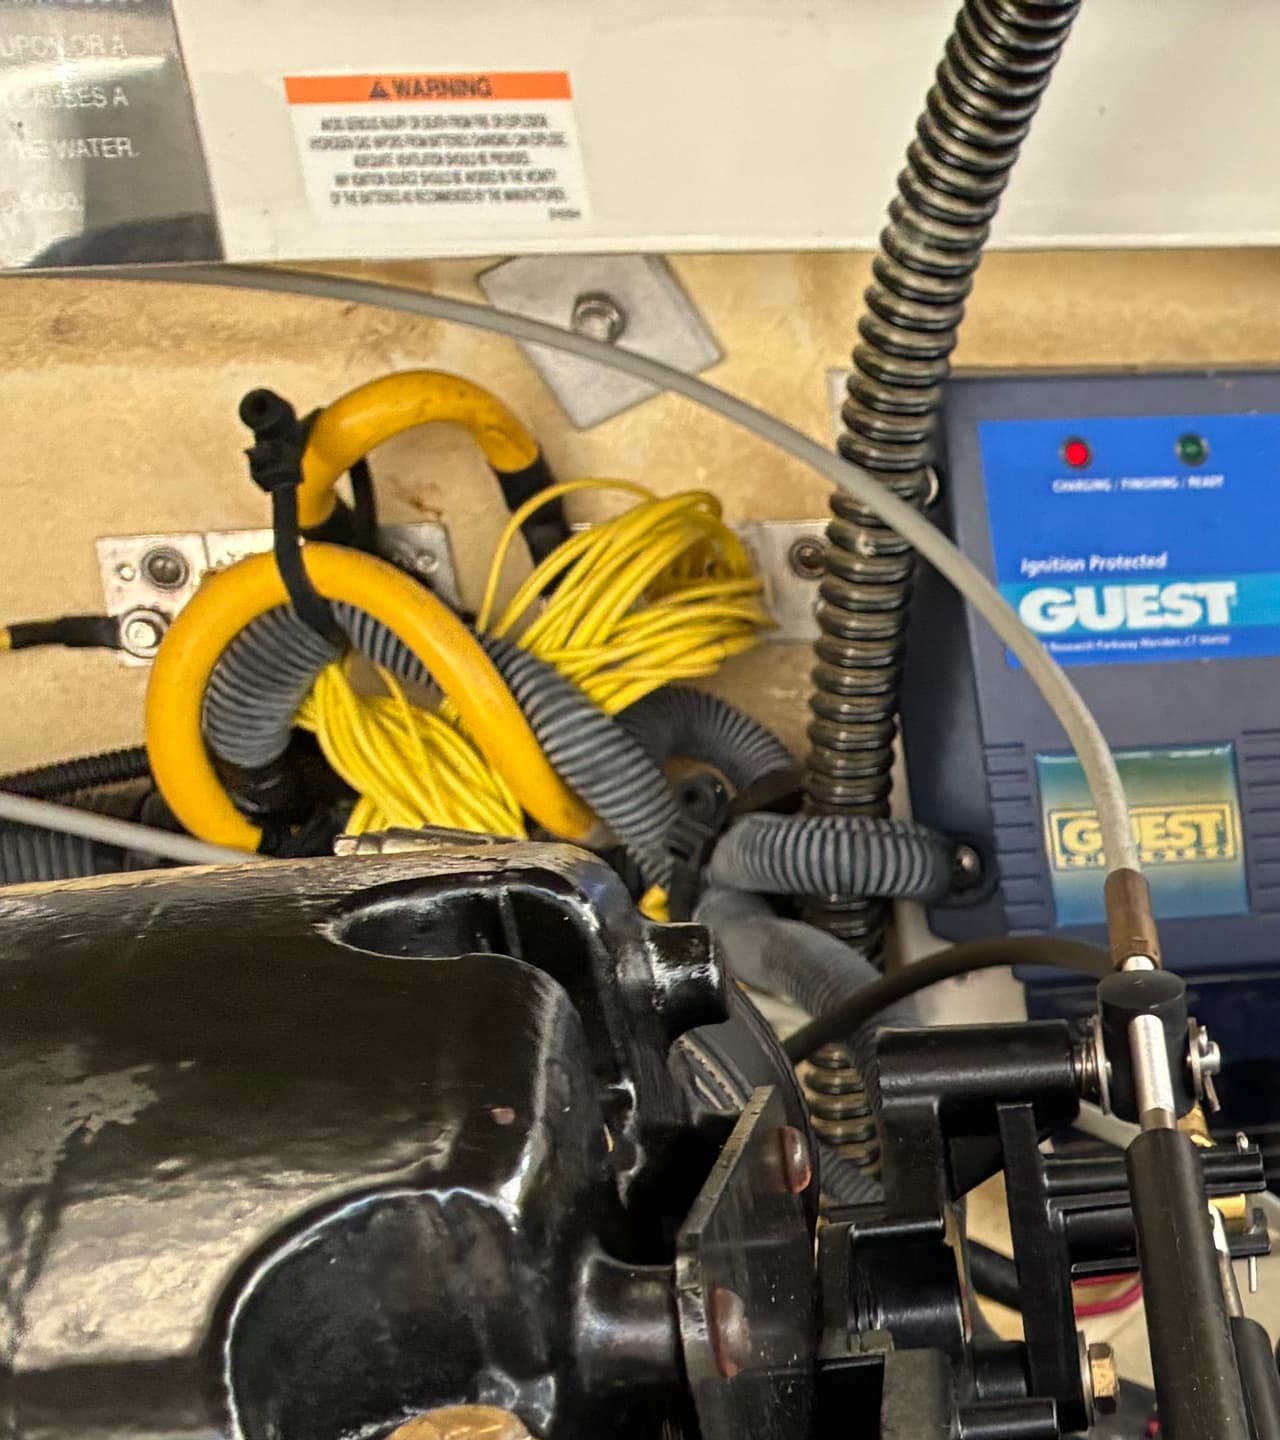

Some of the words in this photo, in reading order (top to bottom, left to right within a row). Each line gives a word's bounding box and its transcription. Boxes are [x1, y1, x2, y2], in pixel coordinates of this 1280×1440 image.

[113, 86, 129, 107] A
[1020, 557, 1085, 578] Ignition
[1089, 552, 1168, 572] Protected
[1018, 580, 1237, 635] GUEST
[1062, 811, 1223, 856] GEST
